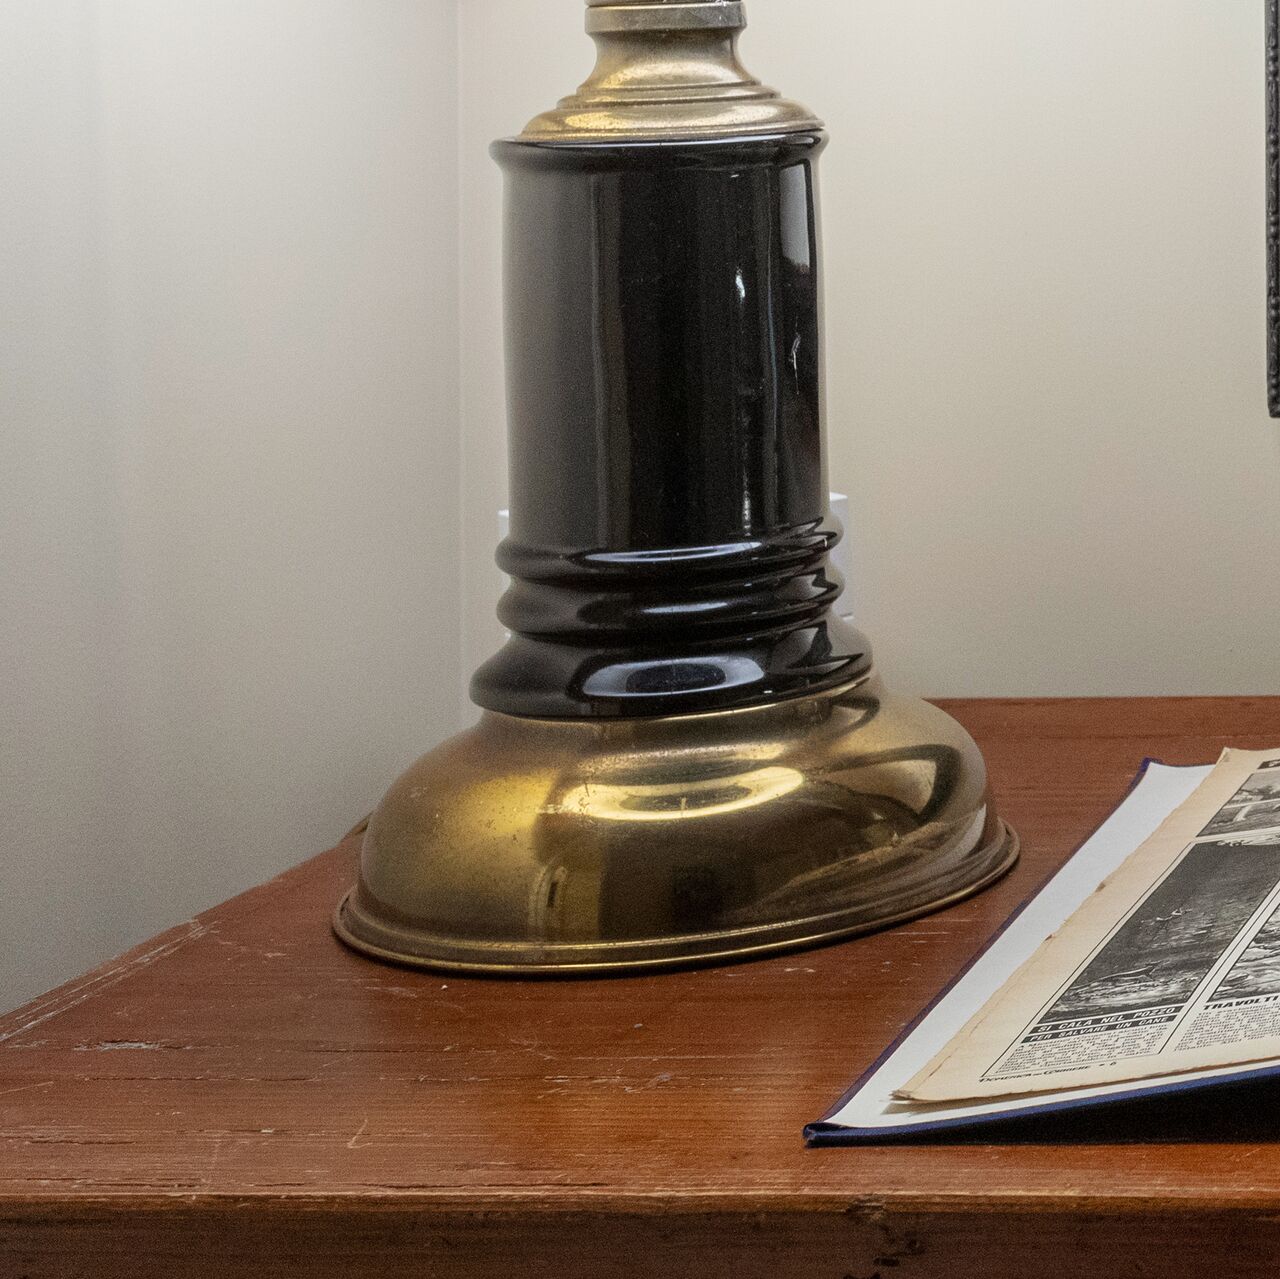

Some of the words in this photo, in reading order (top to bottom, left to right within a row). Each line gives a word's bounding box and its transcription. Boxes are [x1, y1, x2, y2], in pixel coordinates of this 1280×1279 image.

[1203, 995, 1279, 1010] TRAVOLTI
[1029, 1033, 1053, 1042] PER
[1058, 1025, 1109, 1038] SALVARE
[1115, 1021, 1132, 1029] UN
[1137, 1017, 1170, 1026] CANE
[1037, 1025, 1052, 1033] SI
[1058, 1020, 1093, 1030] CALA
[1132, 1007, 1176, 1019] POZZO
